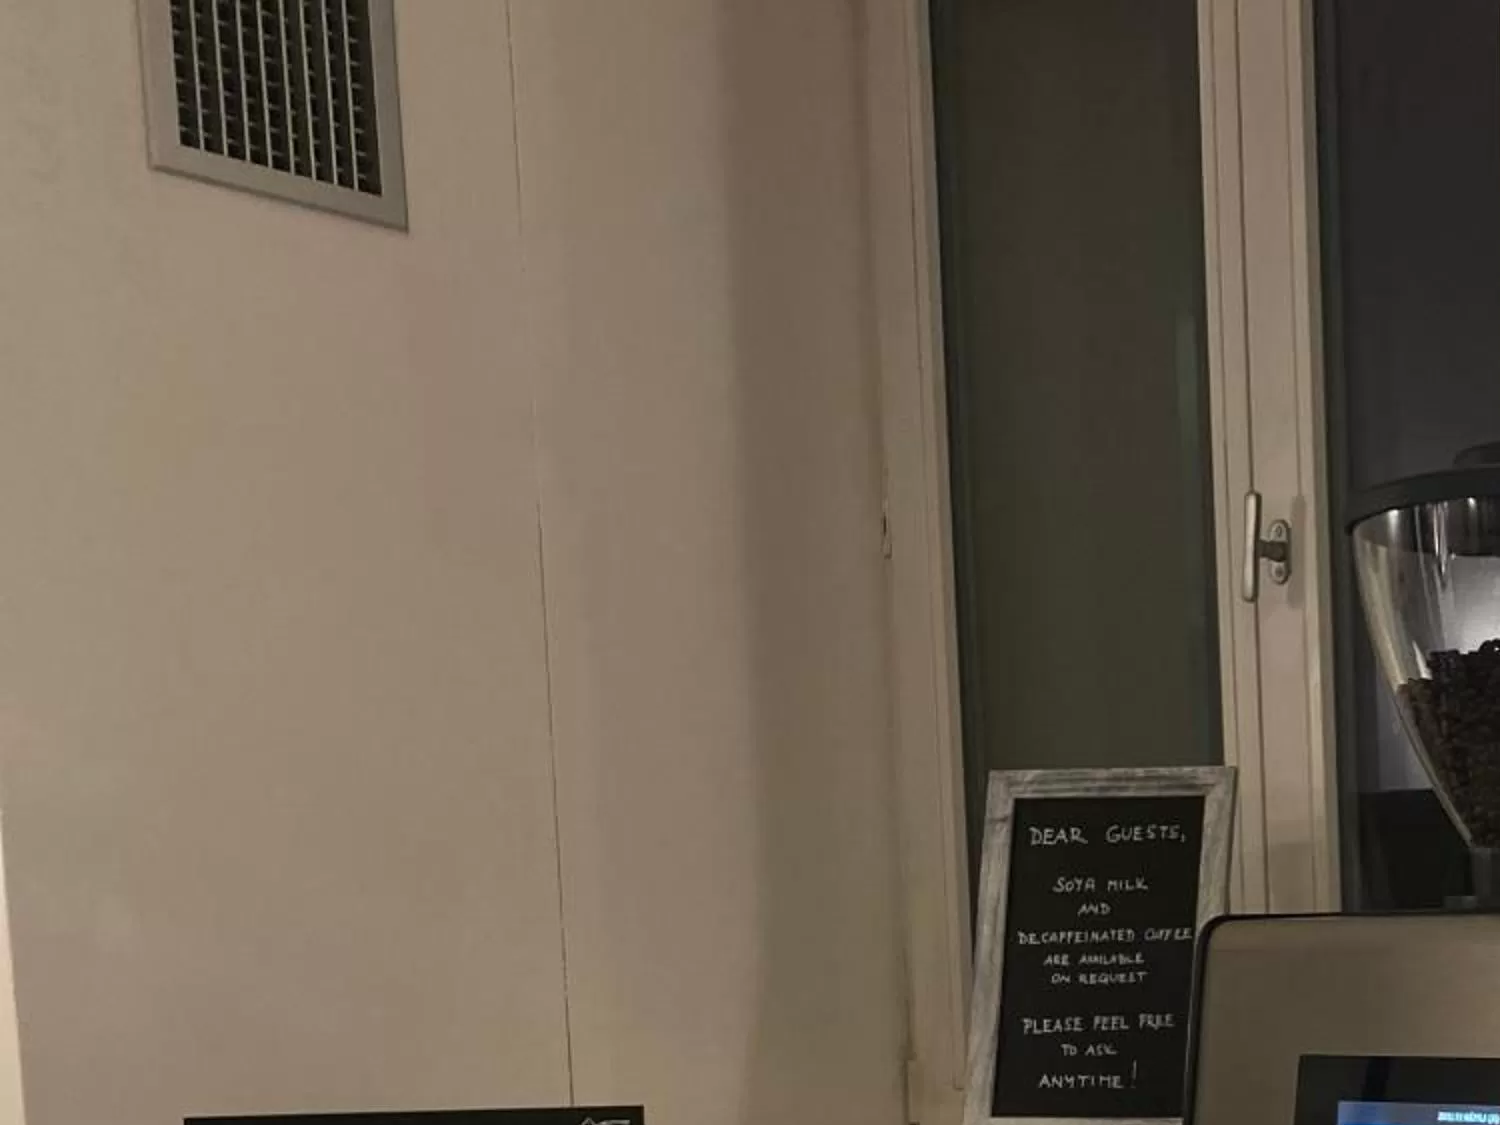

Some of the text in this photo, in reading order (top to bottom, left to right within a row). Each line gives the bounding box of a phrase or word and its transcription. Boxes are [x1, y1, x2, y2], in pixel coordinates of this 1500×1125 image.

[1029, 824, 1187, 845] DEAR GUESTS,
[1052, 876, 1149, 893] SOYA MILK
[1077, 903, 1111, 917] AND
[1017, 927, 1193, 945] DECAFFEINATED COFFEE
[1043, 952, 1145, 966] ARE AVAILABLE
[1051, 971, 1148, 985] ON REQUEST
[1021, 1013, 1175, 1035] PLEASE FEEL FREE
[1061, 1043, 1119, 1056] TO ASK
